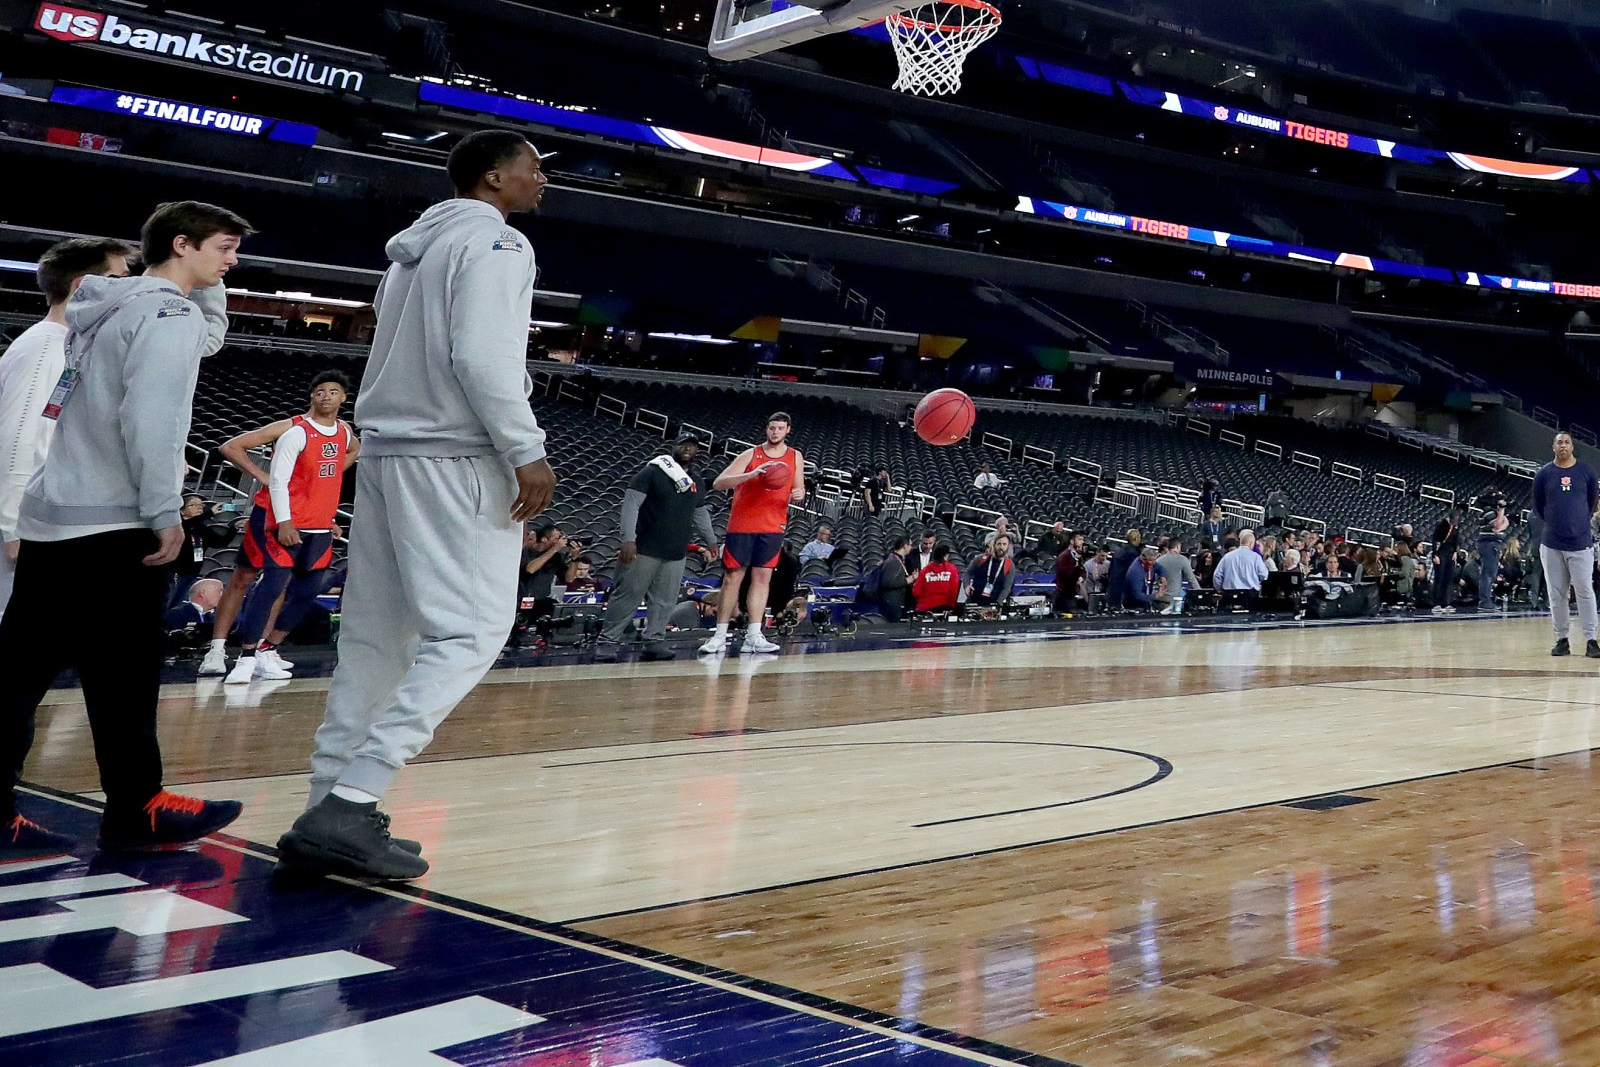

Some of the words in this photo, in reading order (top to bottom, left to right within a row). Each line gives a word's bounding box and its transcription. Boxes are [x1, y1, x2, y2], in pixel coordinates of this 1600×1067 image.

[116, 93, 262, 135] #FINALFOUR
[1235, 112, 1280, 131] AUBURN
[1285, 120, 1349, 149] TIGERS
[1083, 210, 1126, 227] AUBURN
[1130, 215, 1189, 240] TIGERS
[1197, 368, 1273, 386] MINNEAPOLIS
[318, 463, 336, 478] 20
